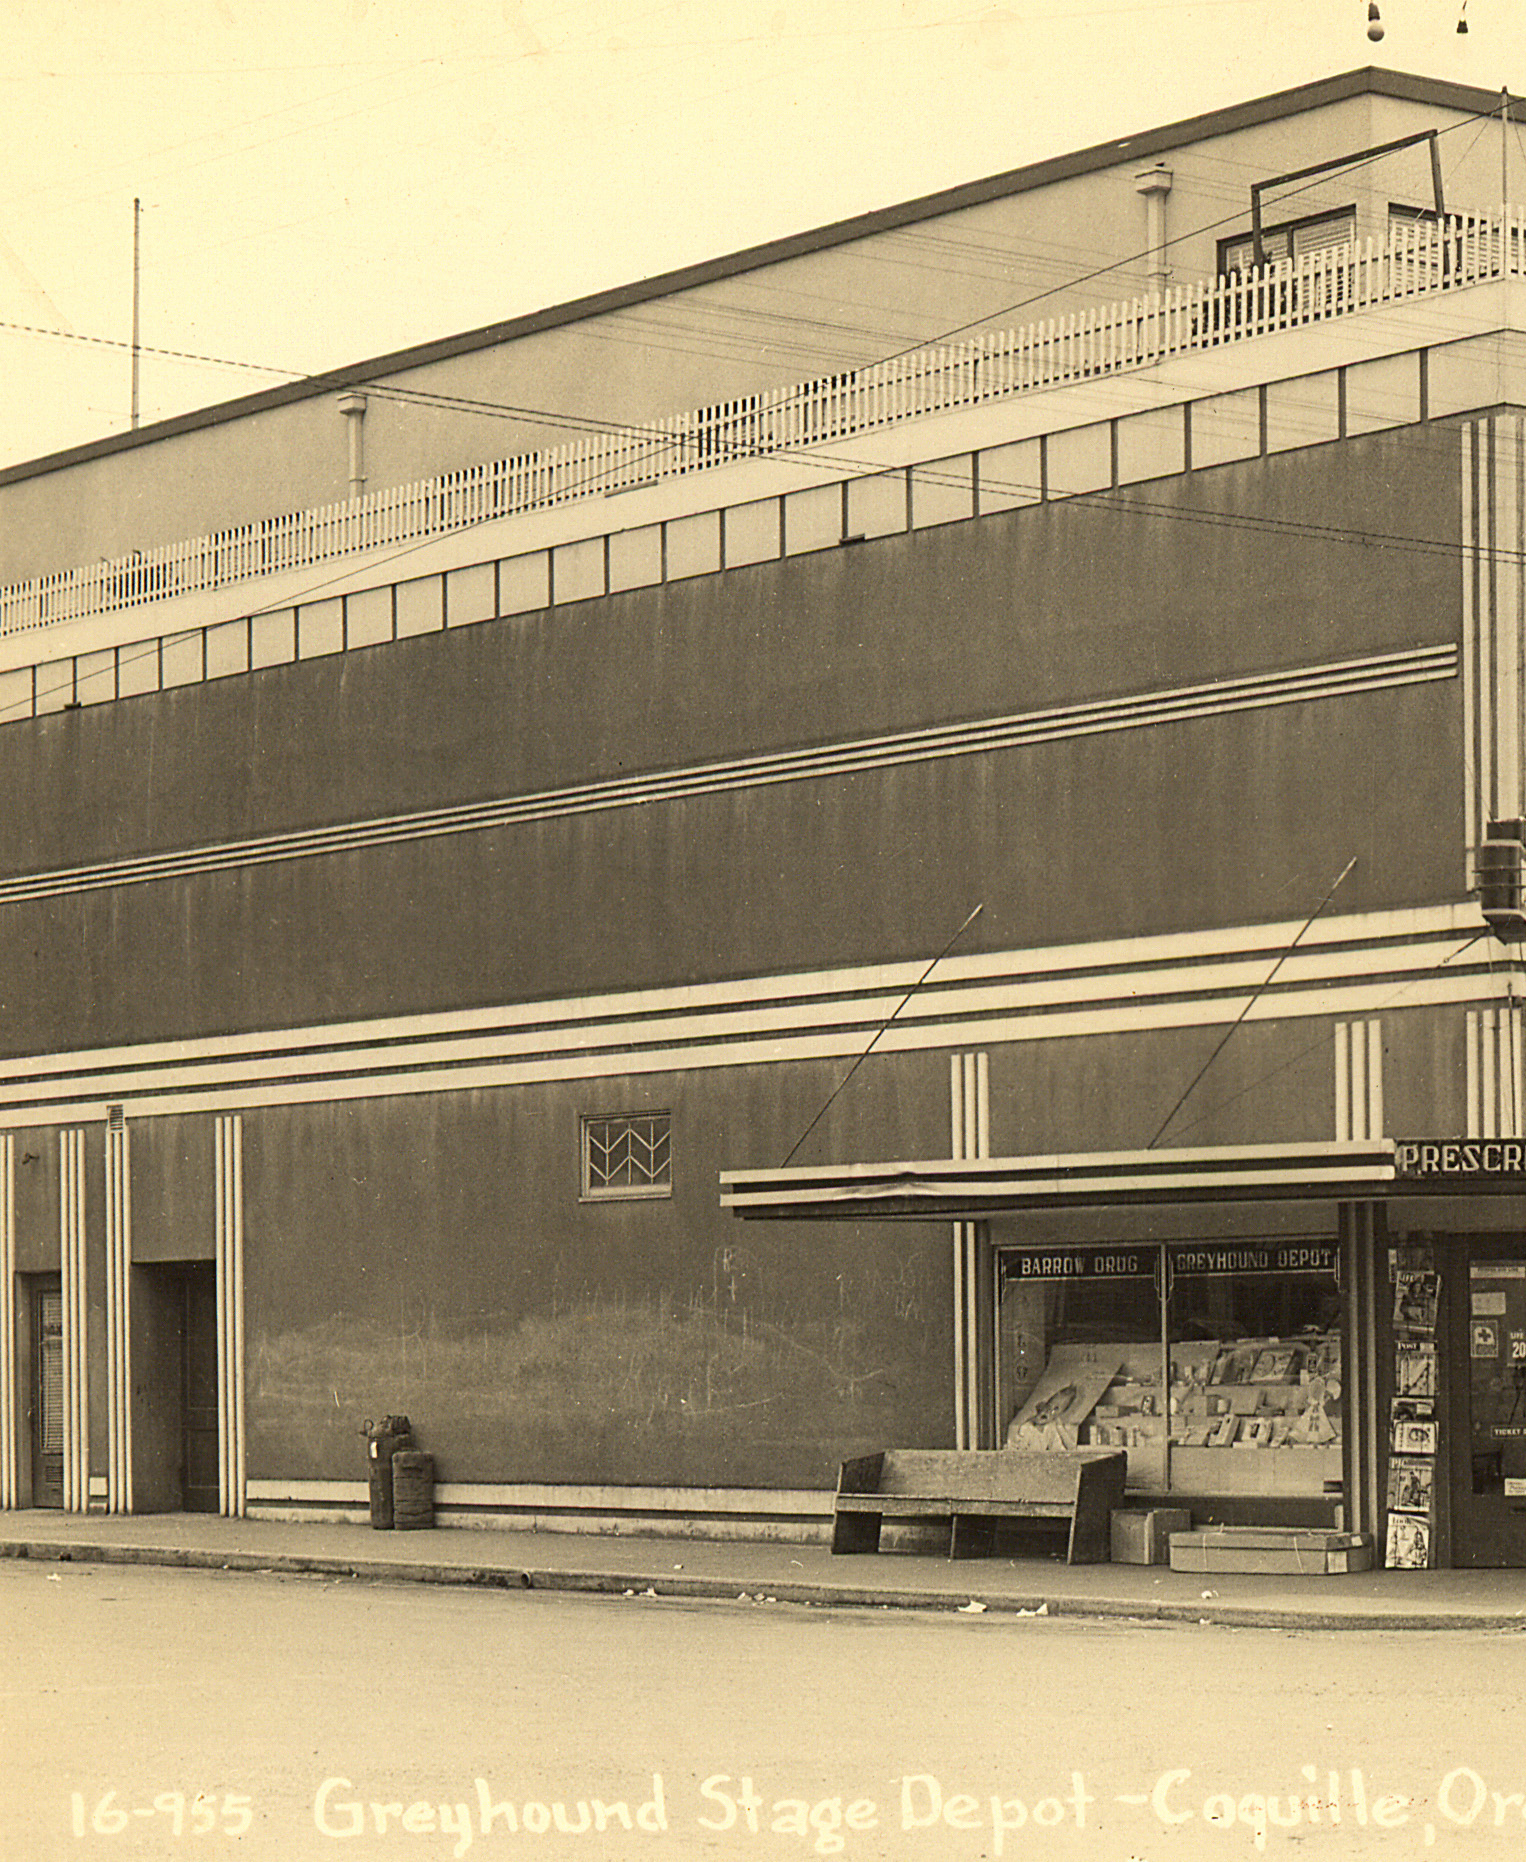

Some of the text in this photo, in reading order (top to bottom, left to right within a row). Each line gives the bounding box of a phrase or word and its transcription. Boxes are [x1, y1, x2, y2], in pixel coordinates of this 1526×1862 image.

[1021, 1255, 1138, 1275] BARROW DRUG
[1177, 1249, 1331, 1271] GREYHOUND DEPOT
[1494, 1428, 1521, 1436] TICKET
